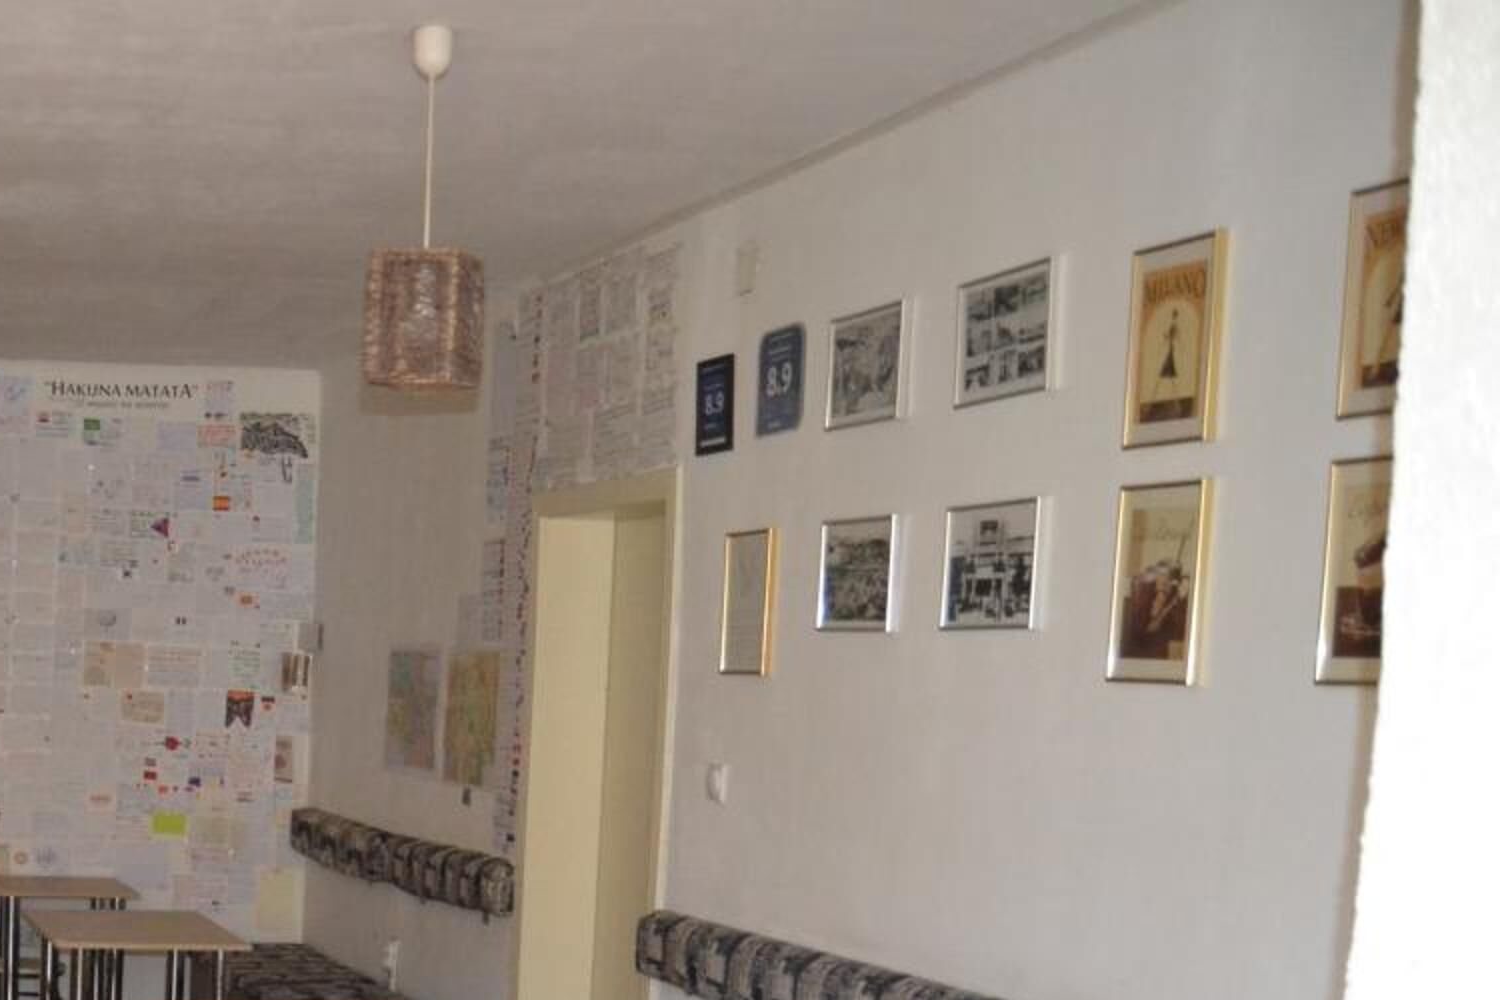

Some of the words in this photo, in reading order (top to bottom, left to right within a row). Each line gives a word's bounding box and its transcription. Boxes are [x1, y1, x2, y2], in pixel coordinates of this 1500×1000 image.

[1145, 268, 1205, 303] MILANO
[766, 361, 793, 397] 8.9
[704, 391, 725, 415] 8.9
